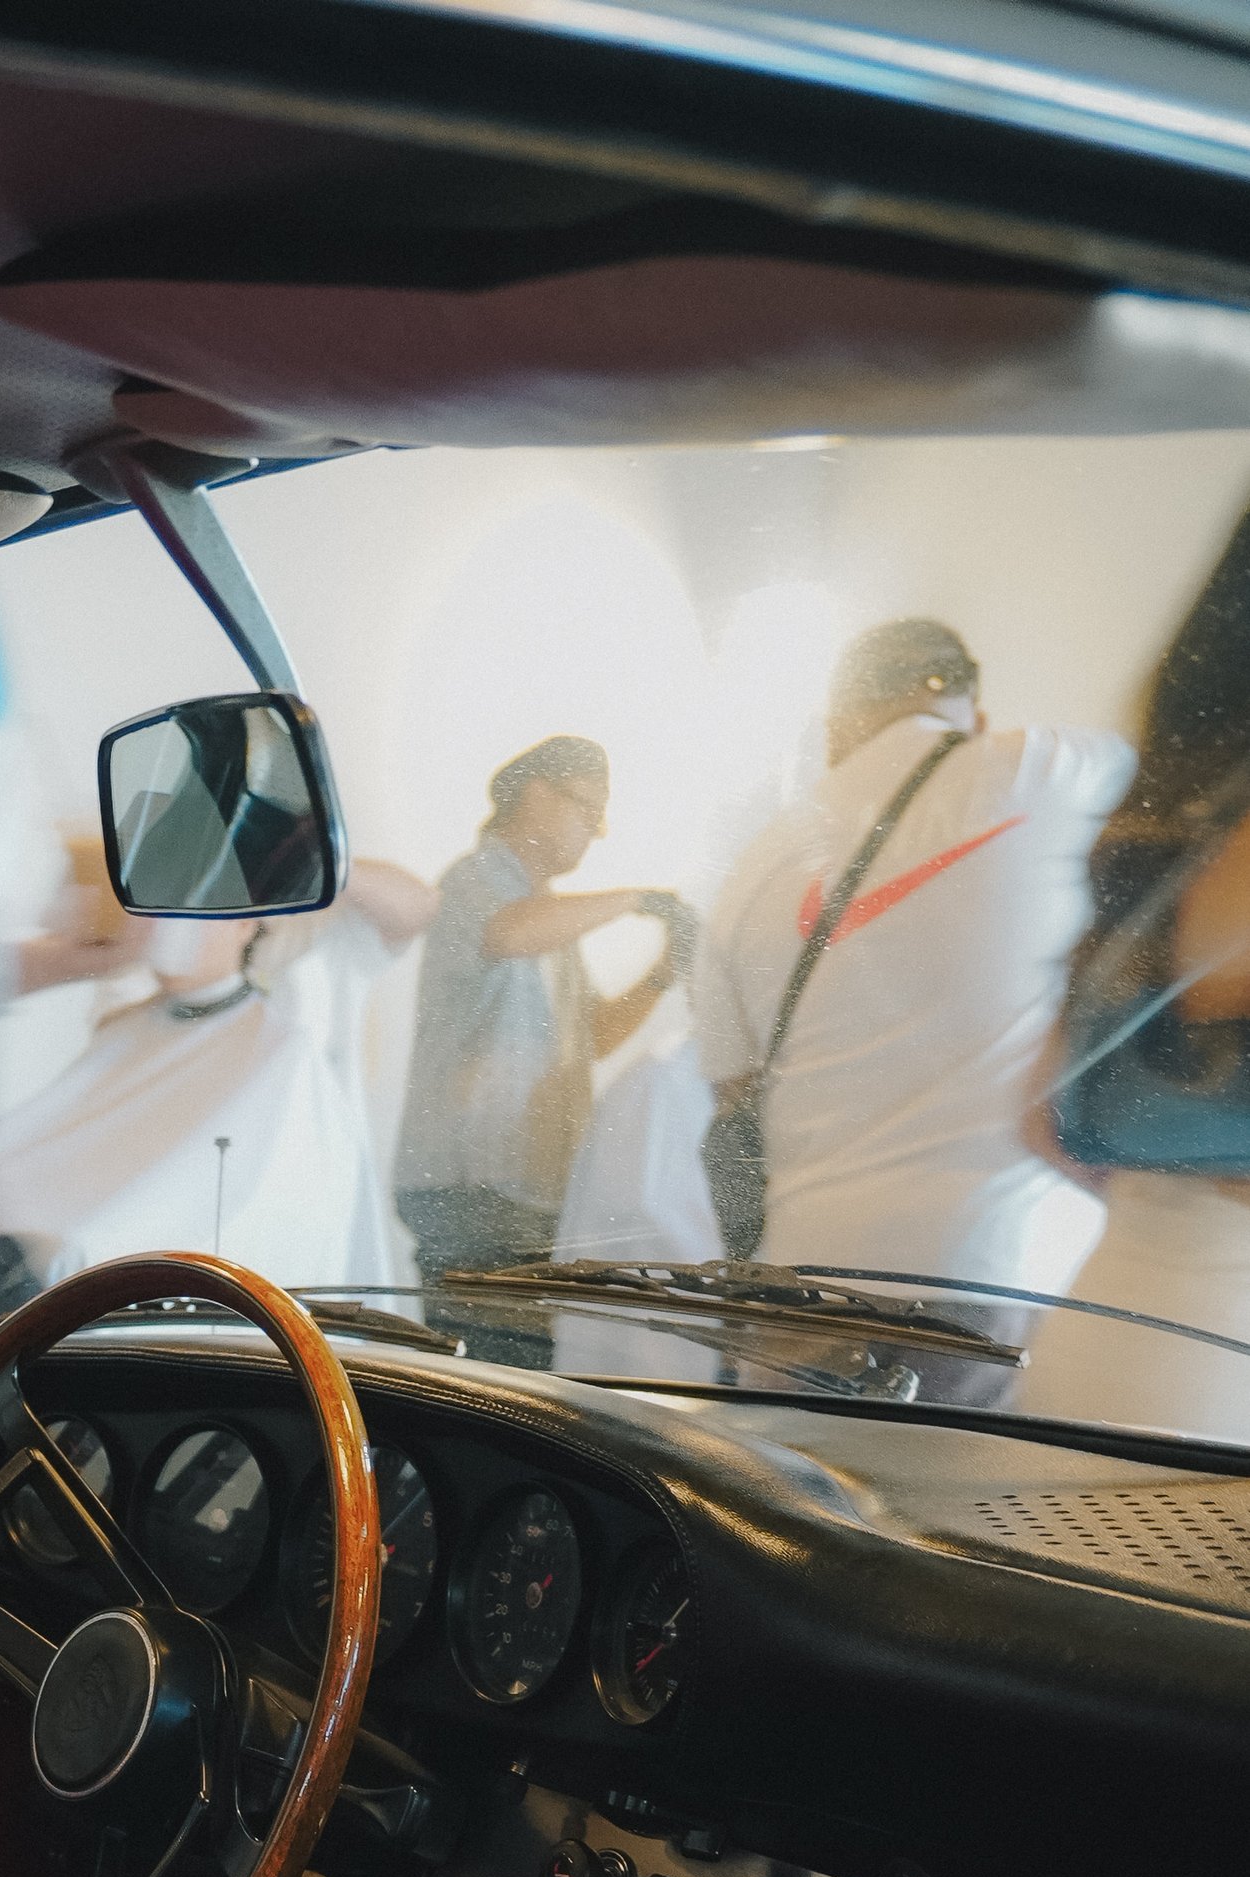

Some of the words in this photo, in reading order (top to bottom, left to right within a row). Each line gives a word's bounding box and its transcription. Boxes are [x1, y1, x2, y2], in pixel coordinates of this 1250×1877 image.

[510, 1544, 524, 1556] 40
[498, 1572, 512, 1585] 30
[413, 1601, 423, 1617] 7
[495, 1603, 509, 1616] 20
[502, 1632, 512, 1644] 10
[521, 1658, 544, 1674] MPH
